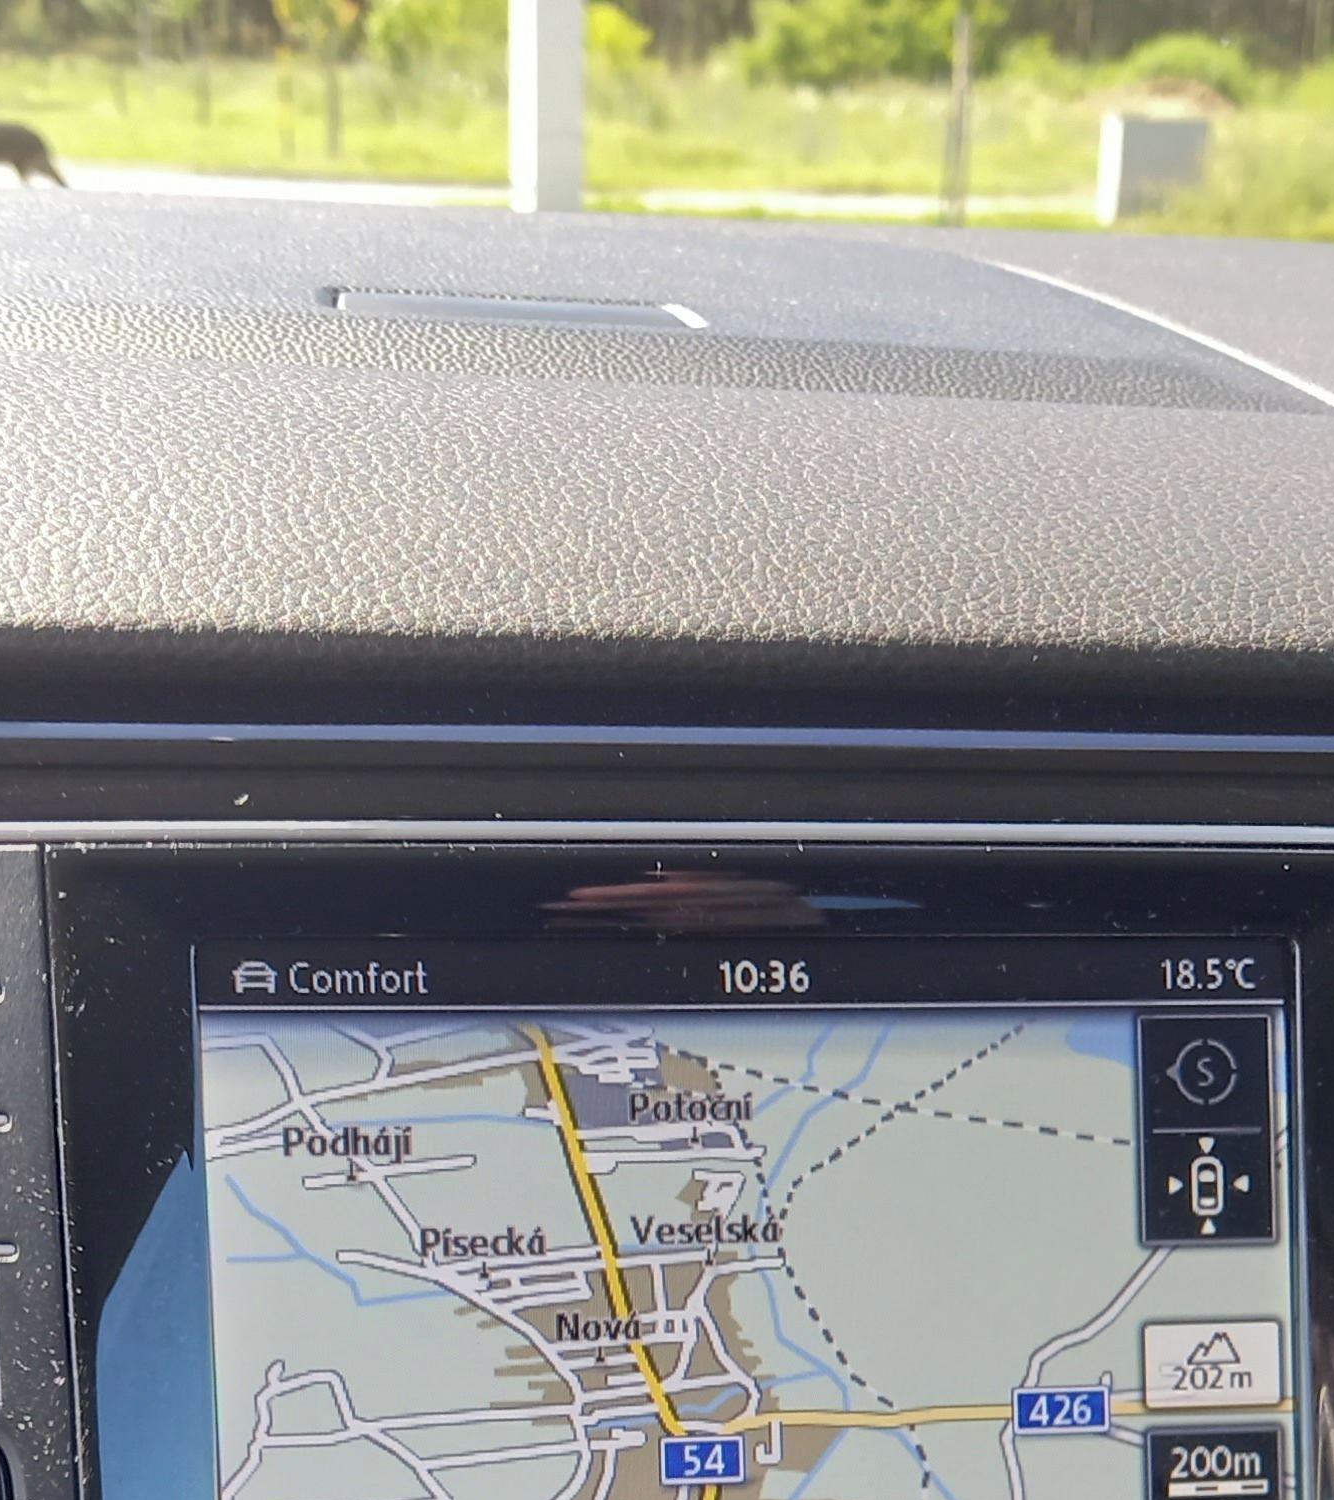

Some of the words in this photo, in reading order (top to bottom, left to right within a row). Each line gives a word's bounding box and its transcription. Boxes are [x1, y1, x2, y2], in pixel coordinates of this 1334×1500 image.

[288, 961, 429, 996] Comfort
[719, 960, 810, 994] 10:36
[1160, 957, 1256, 990] 18.5°C
[628, 1091, 754, 1122] Potoční
[282, 1125, 413, 1162] Podhájí
[419, 1225, 547, 1257] Písecká
[631, 1213, 781, 1246] Veselská
[555, 1310, 642, 1341] Nová
[1172, 1366, 1224, 1391] 202
[1229, 1371, 1253, 1389] m
[1028, 1394, 1093, 1426] 426
[682, 1444, 726, 1477] 54
[1169, 1445, 1261, 1479] 200m
